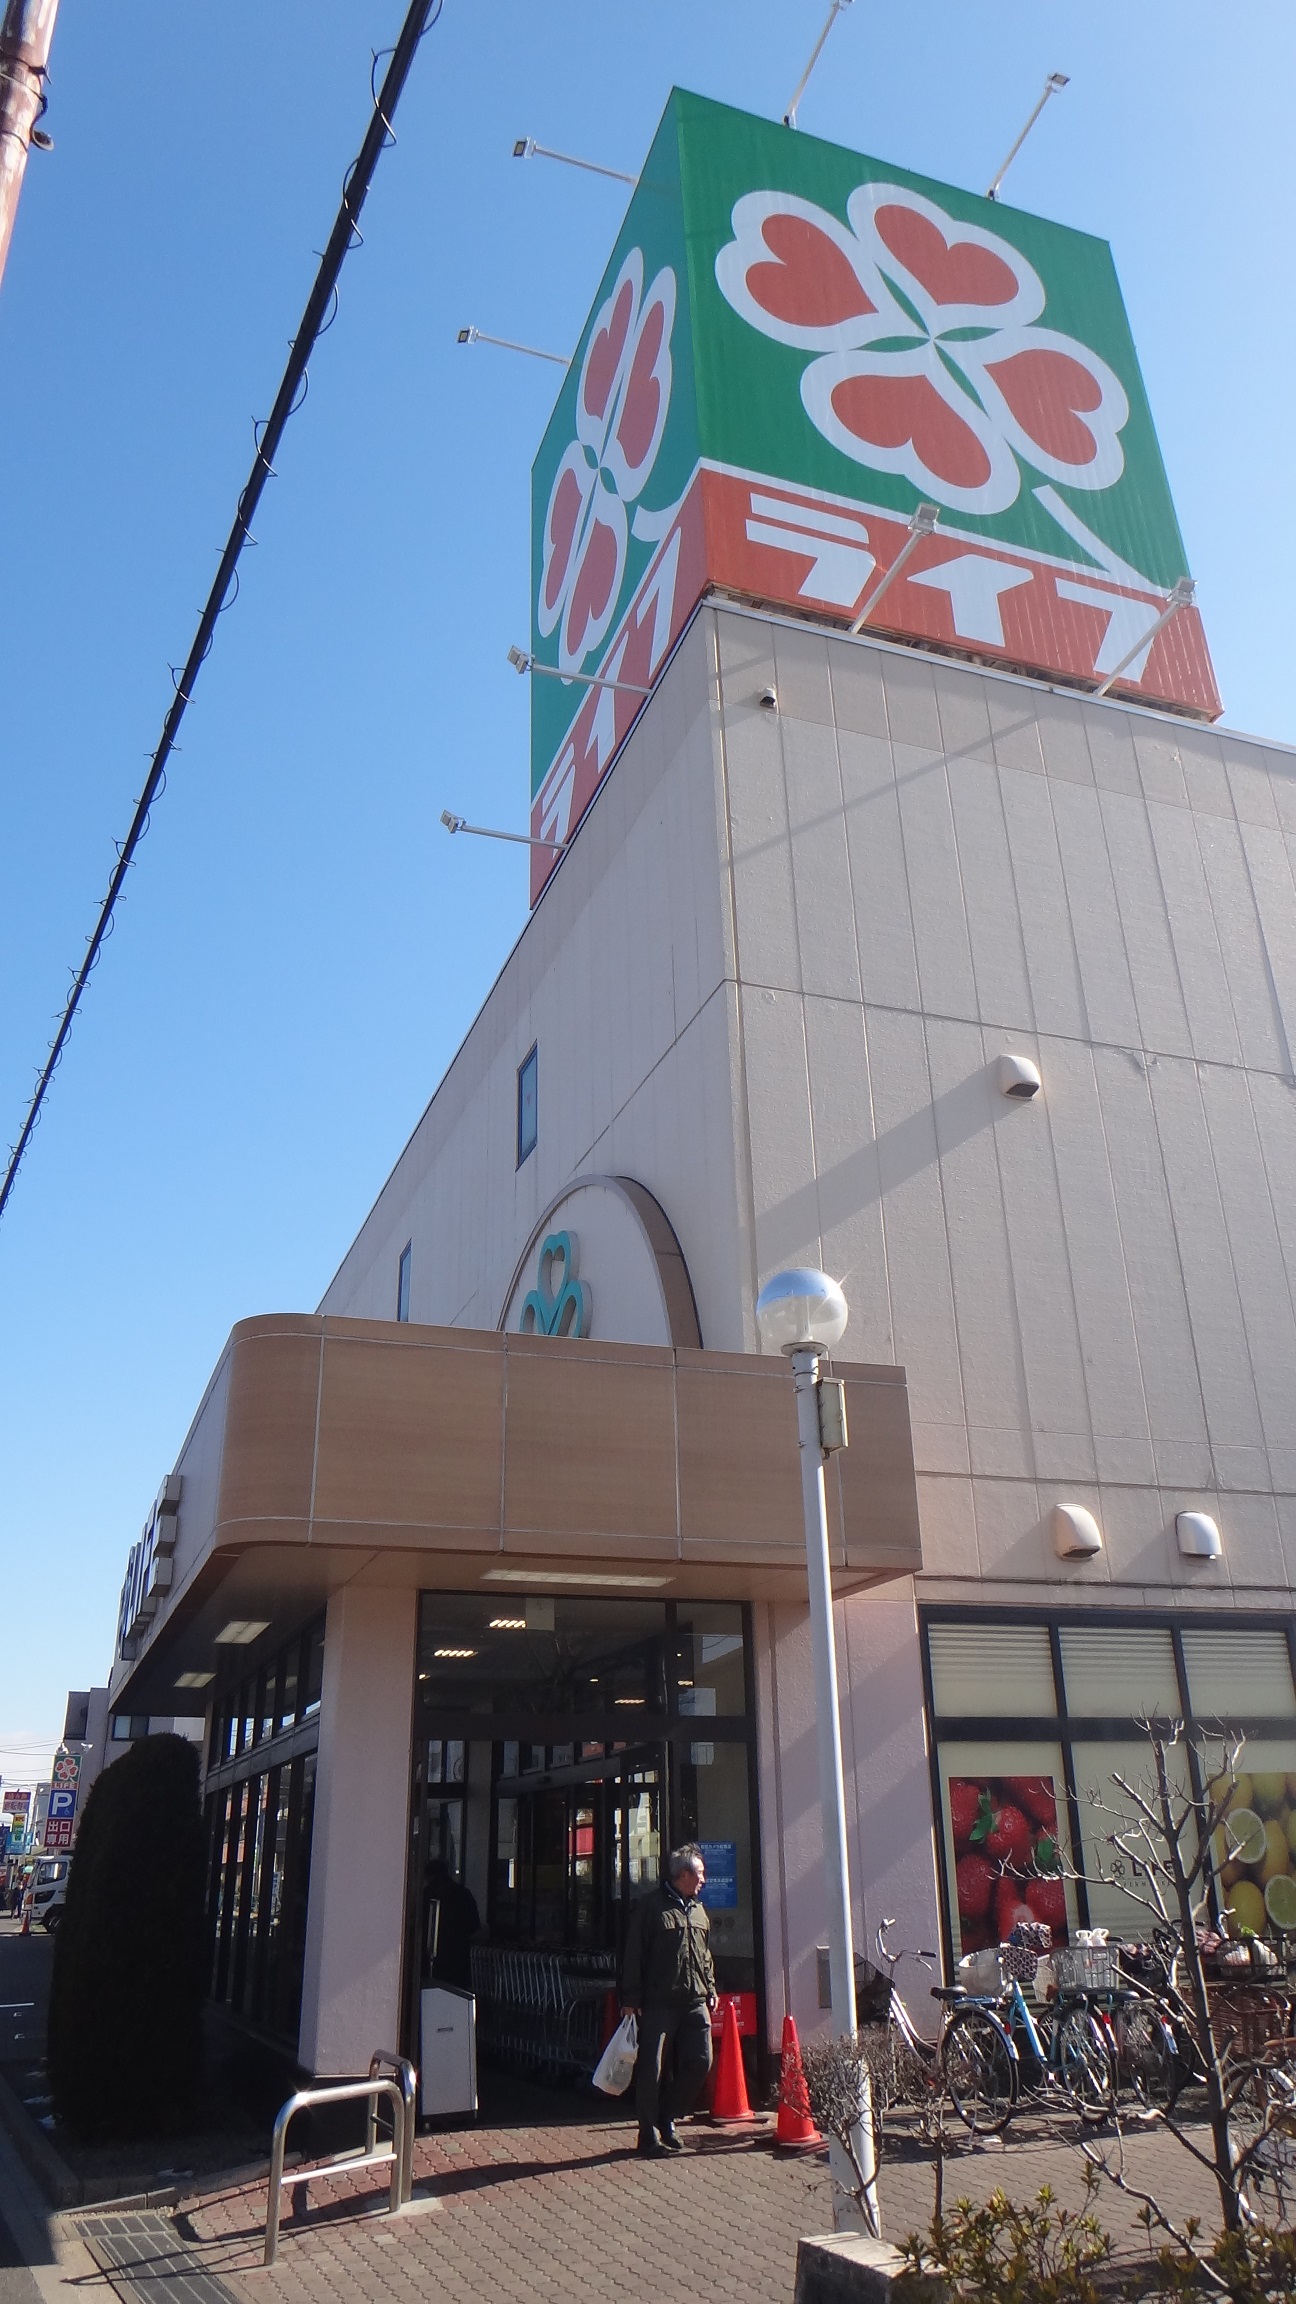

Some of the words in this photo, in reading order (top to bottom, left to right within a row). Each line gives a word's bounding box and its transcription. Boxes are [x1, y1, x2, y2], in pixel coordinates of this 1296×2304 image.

[746, 492, 1161, 683] ライフ
[540, 526, 681, 860] ライフ
[47, 1820, 71, 1832] 出口
[51, 1792, 73, 1815] P
